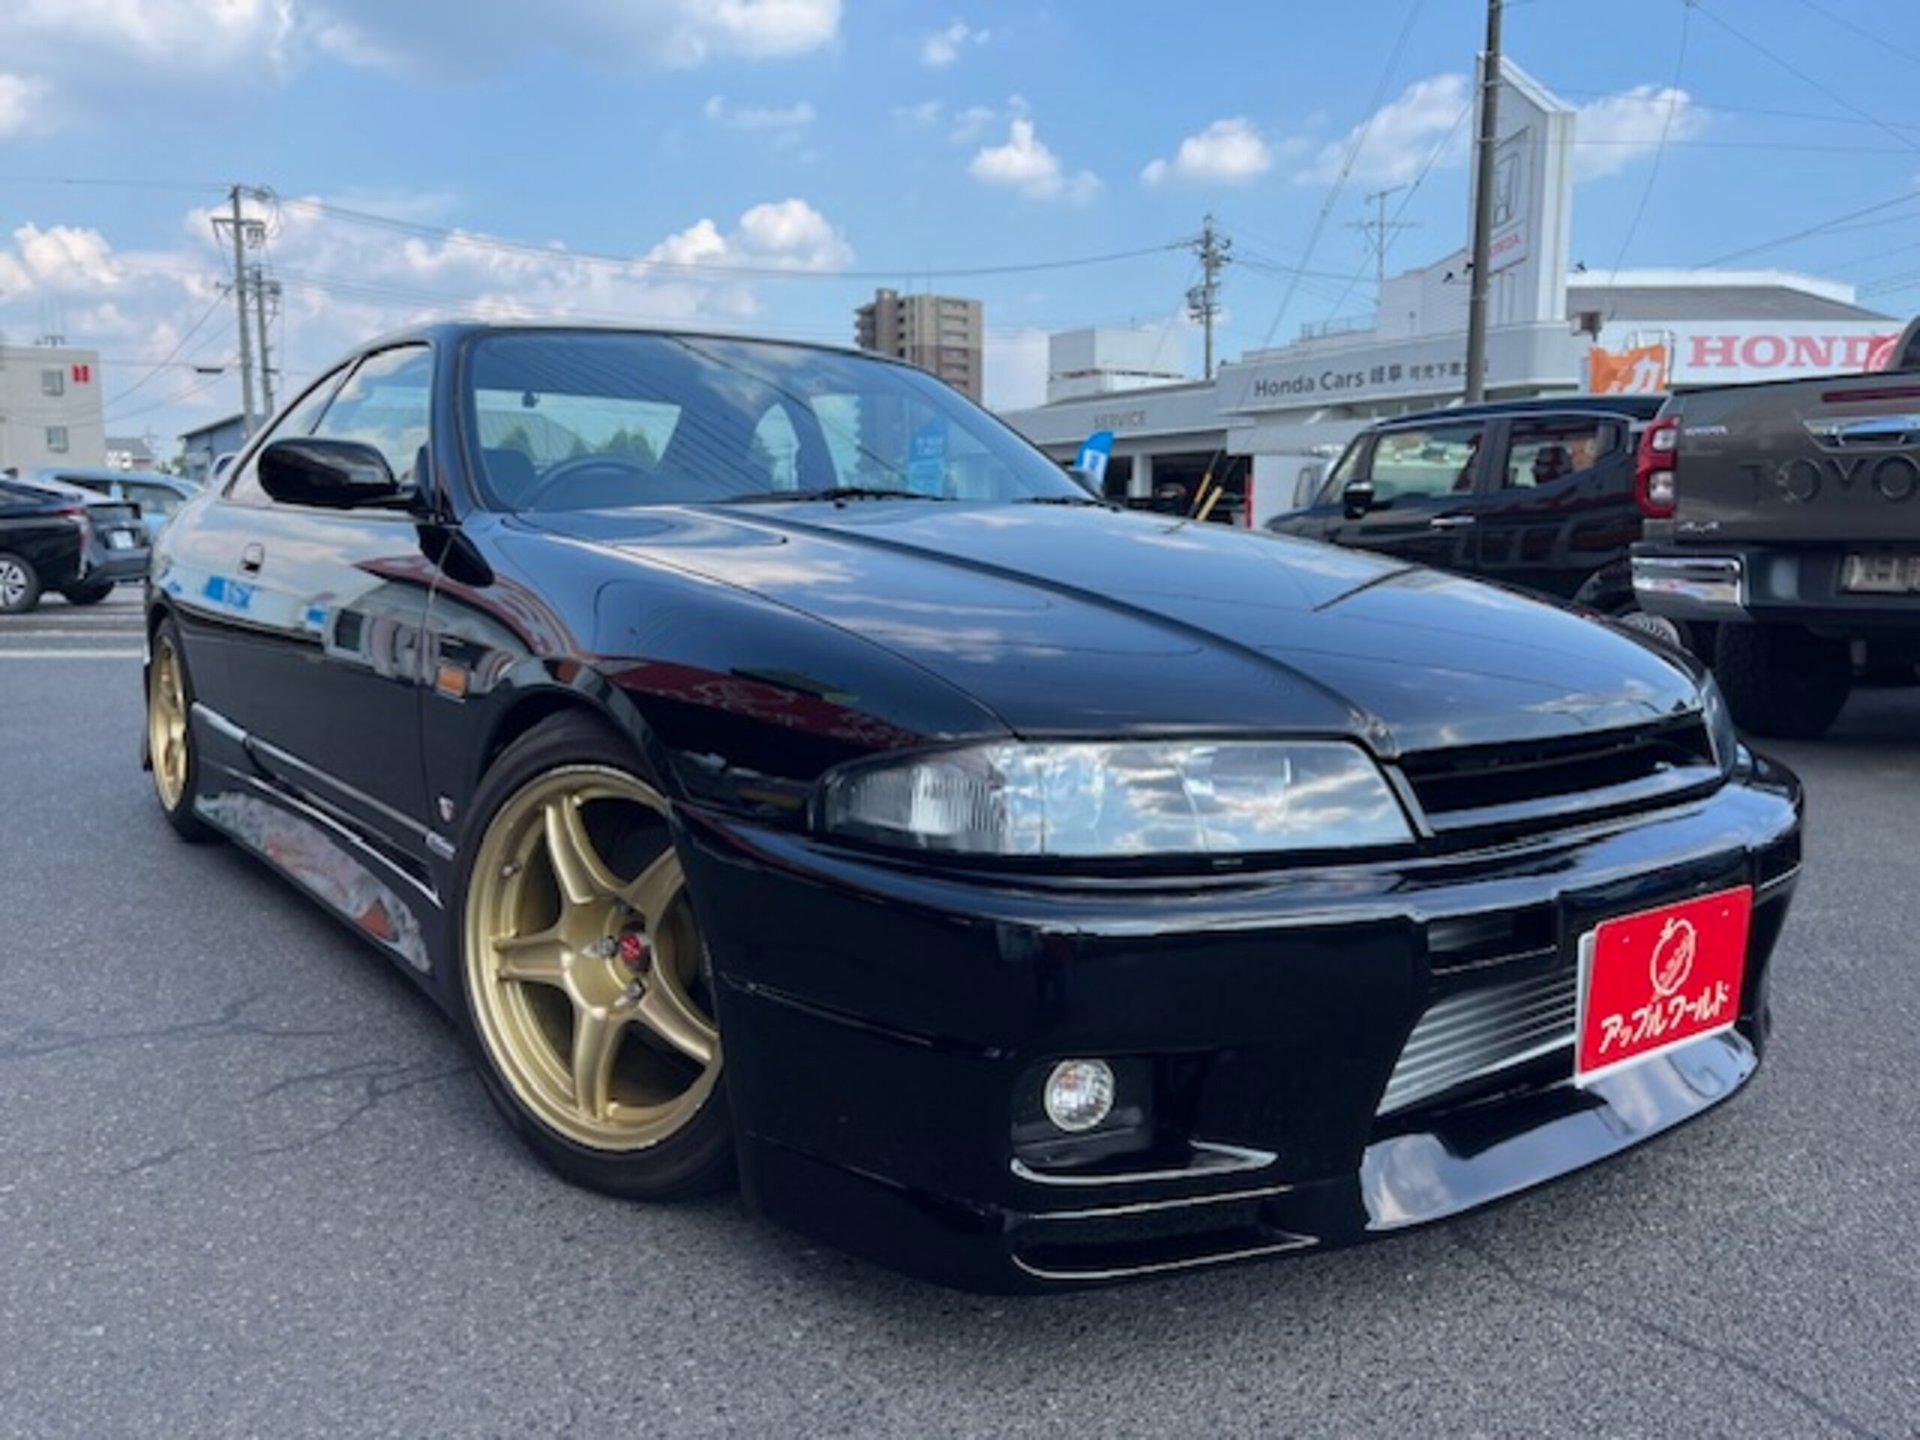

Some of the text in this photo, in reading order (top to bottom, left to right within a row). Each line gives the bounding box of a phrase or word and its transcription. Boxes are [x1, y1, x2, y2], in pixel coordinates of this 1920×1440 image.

[1253, 374, 1315, 398] Honda
[1319, 368, 1364, 392] Cars
[1093, 410, 1147, 430] SERVICE
[1599, 980, 1731, 1054] アップルワールド
